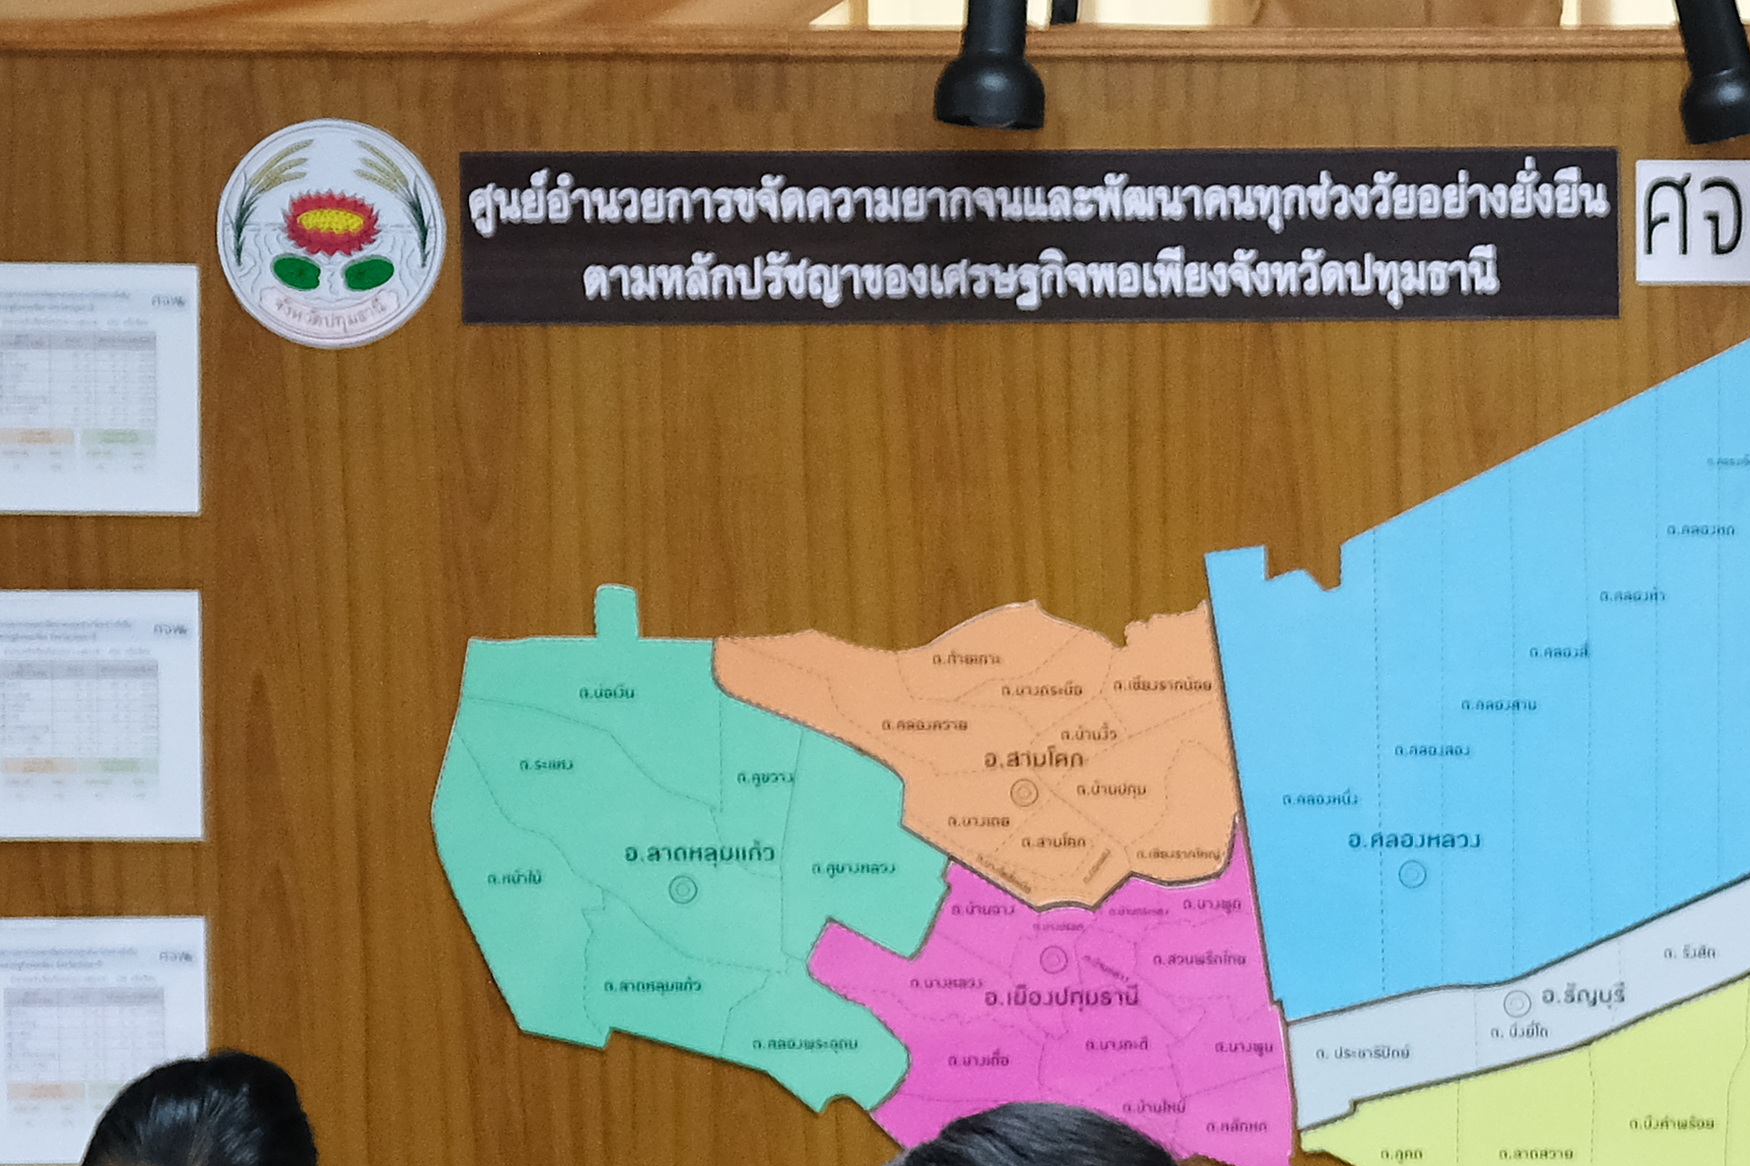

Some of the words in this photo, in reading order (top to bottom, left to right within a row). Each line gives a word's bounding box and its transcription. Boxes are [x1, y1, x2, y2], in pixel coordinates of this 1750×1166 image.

[469, 157, 1610, 237] ศูนย์อำนวยการขจัดความยากจนและพัฒนาคนทุกช่วงวัยอย่างยั่งยืน
[584, 244, 1500, 310] ตามหลักปรัชญาของเศรษฐกิจพอเพียงจังหวัดปทุมธานี
[984, 744, 1085, 769] อ.สามโคก
[624, 839, 776, 868] อ.ลาดหลุมแก้ว
[1348, 831, 1481, 849] อ.คลองหลวง
[984, 983, 1141, 1014] อ.เมืองปทุมธานี
[1541, 981, 1626, 1010] อ.ธัญบุรี
